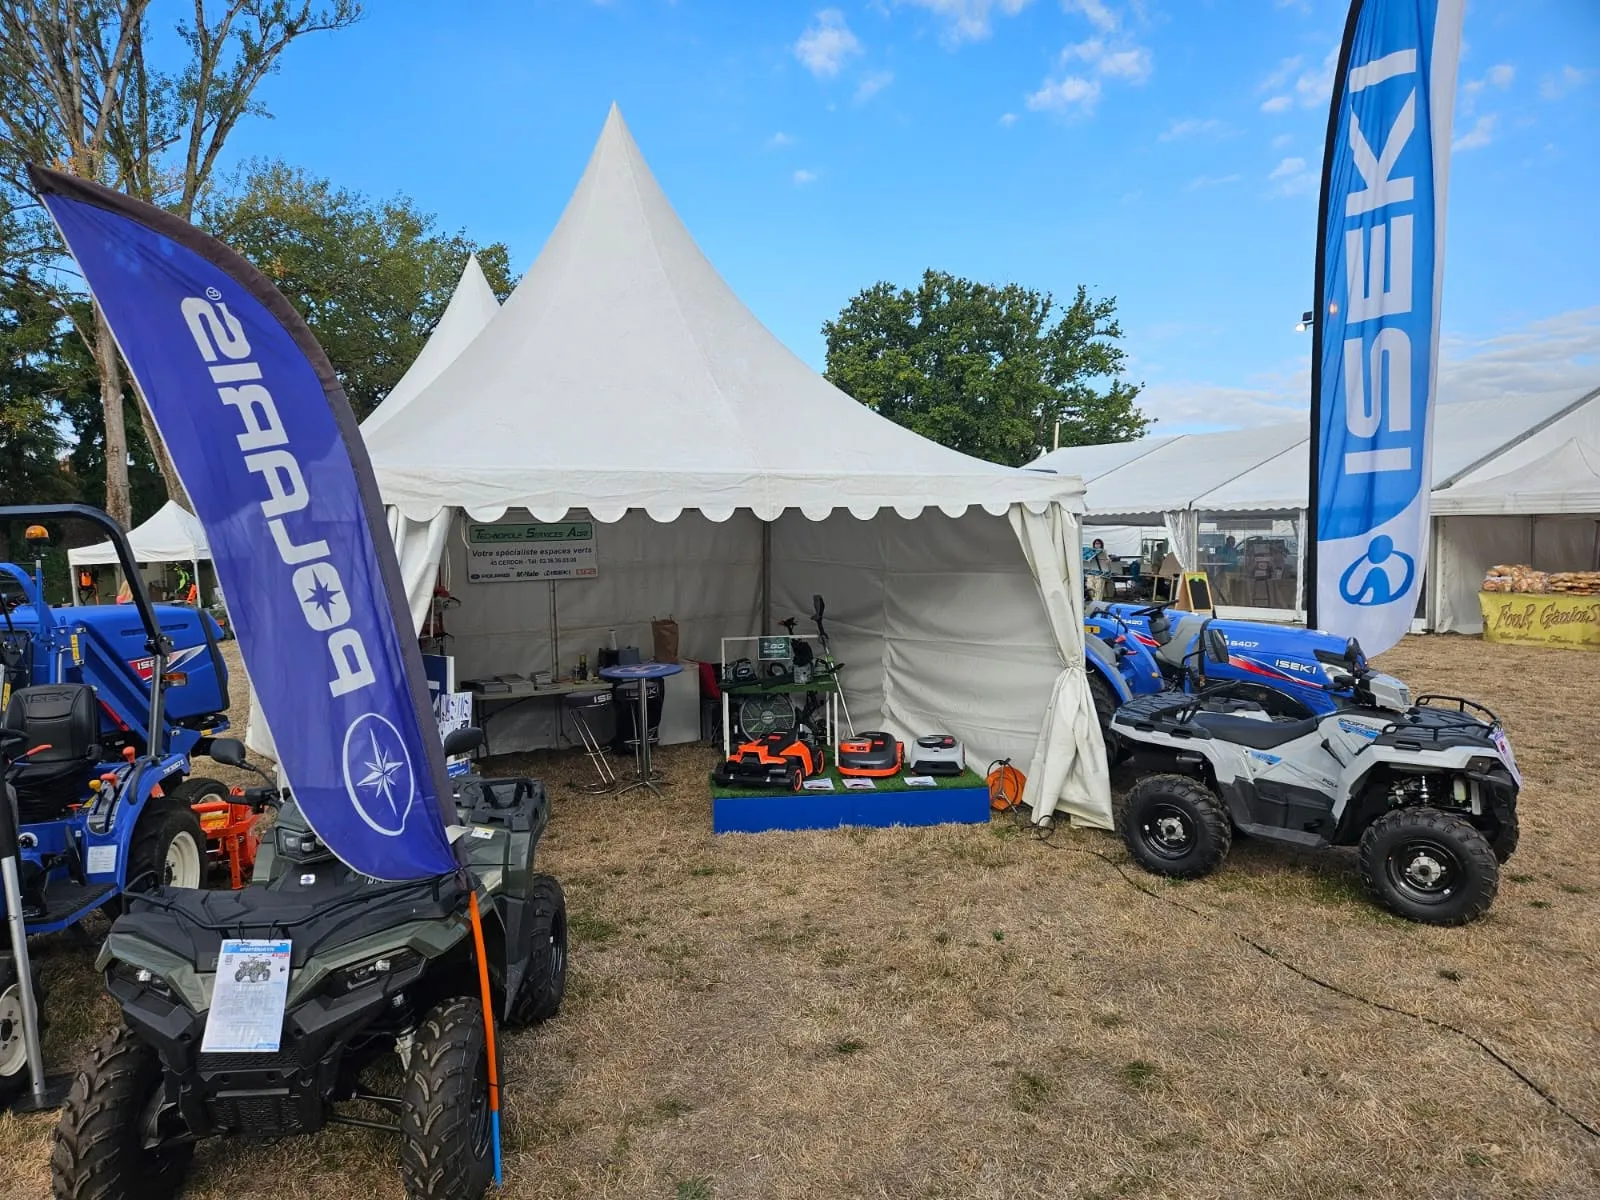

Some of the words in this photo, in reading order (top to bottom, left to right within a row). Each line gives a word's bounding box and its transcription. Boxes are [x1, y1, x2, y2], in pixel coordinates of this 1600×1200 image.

[1345, 48, 1417, 476] ISEKI
[472, 549, 493, 557] Votre
[495, 548, 538, 558] spécialiste
[539, 547, 571, 556] espaces
[573, 546, 592, 554] verts
[1275, 658, 1317, 675] ISEKI
